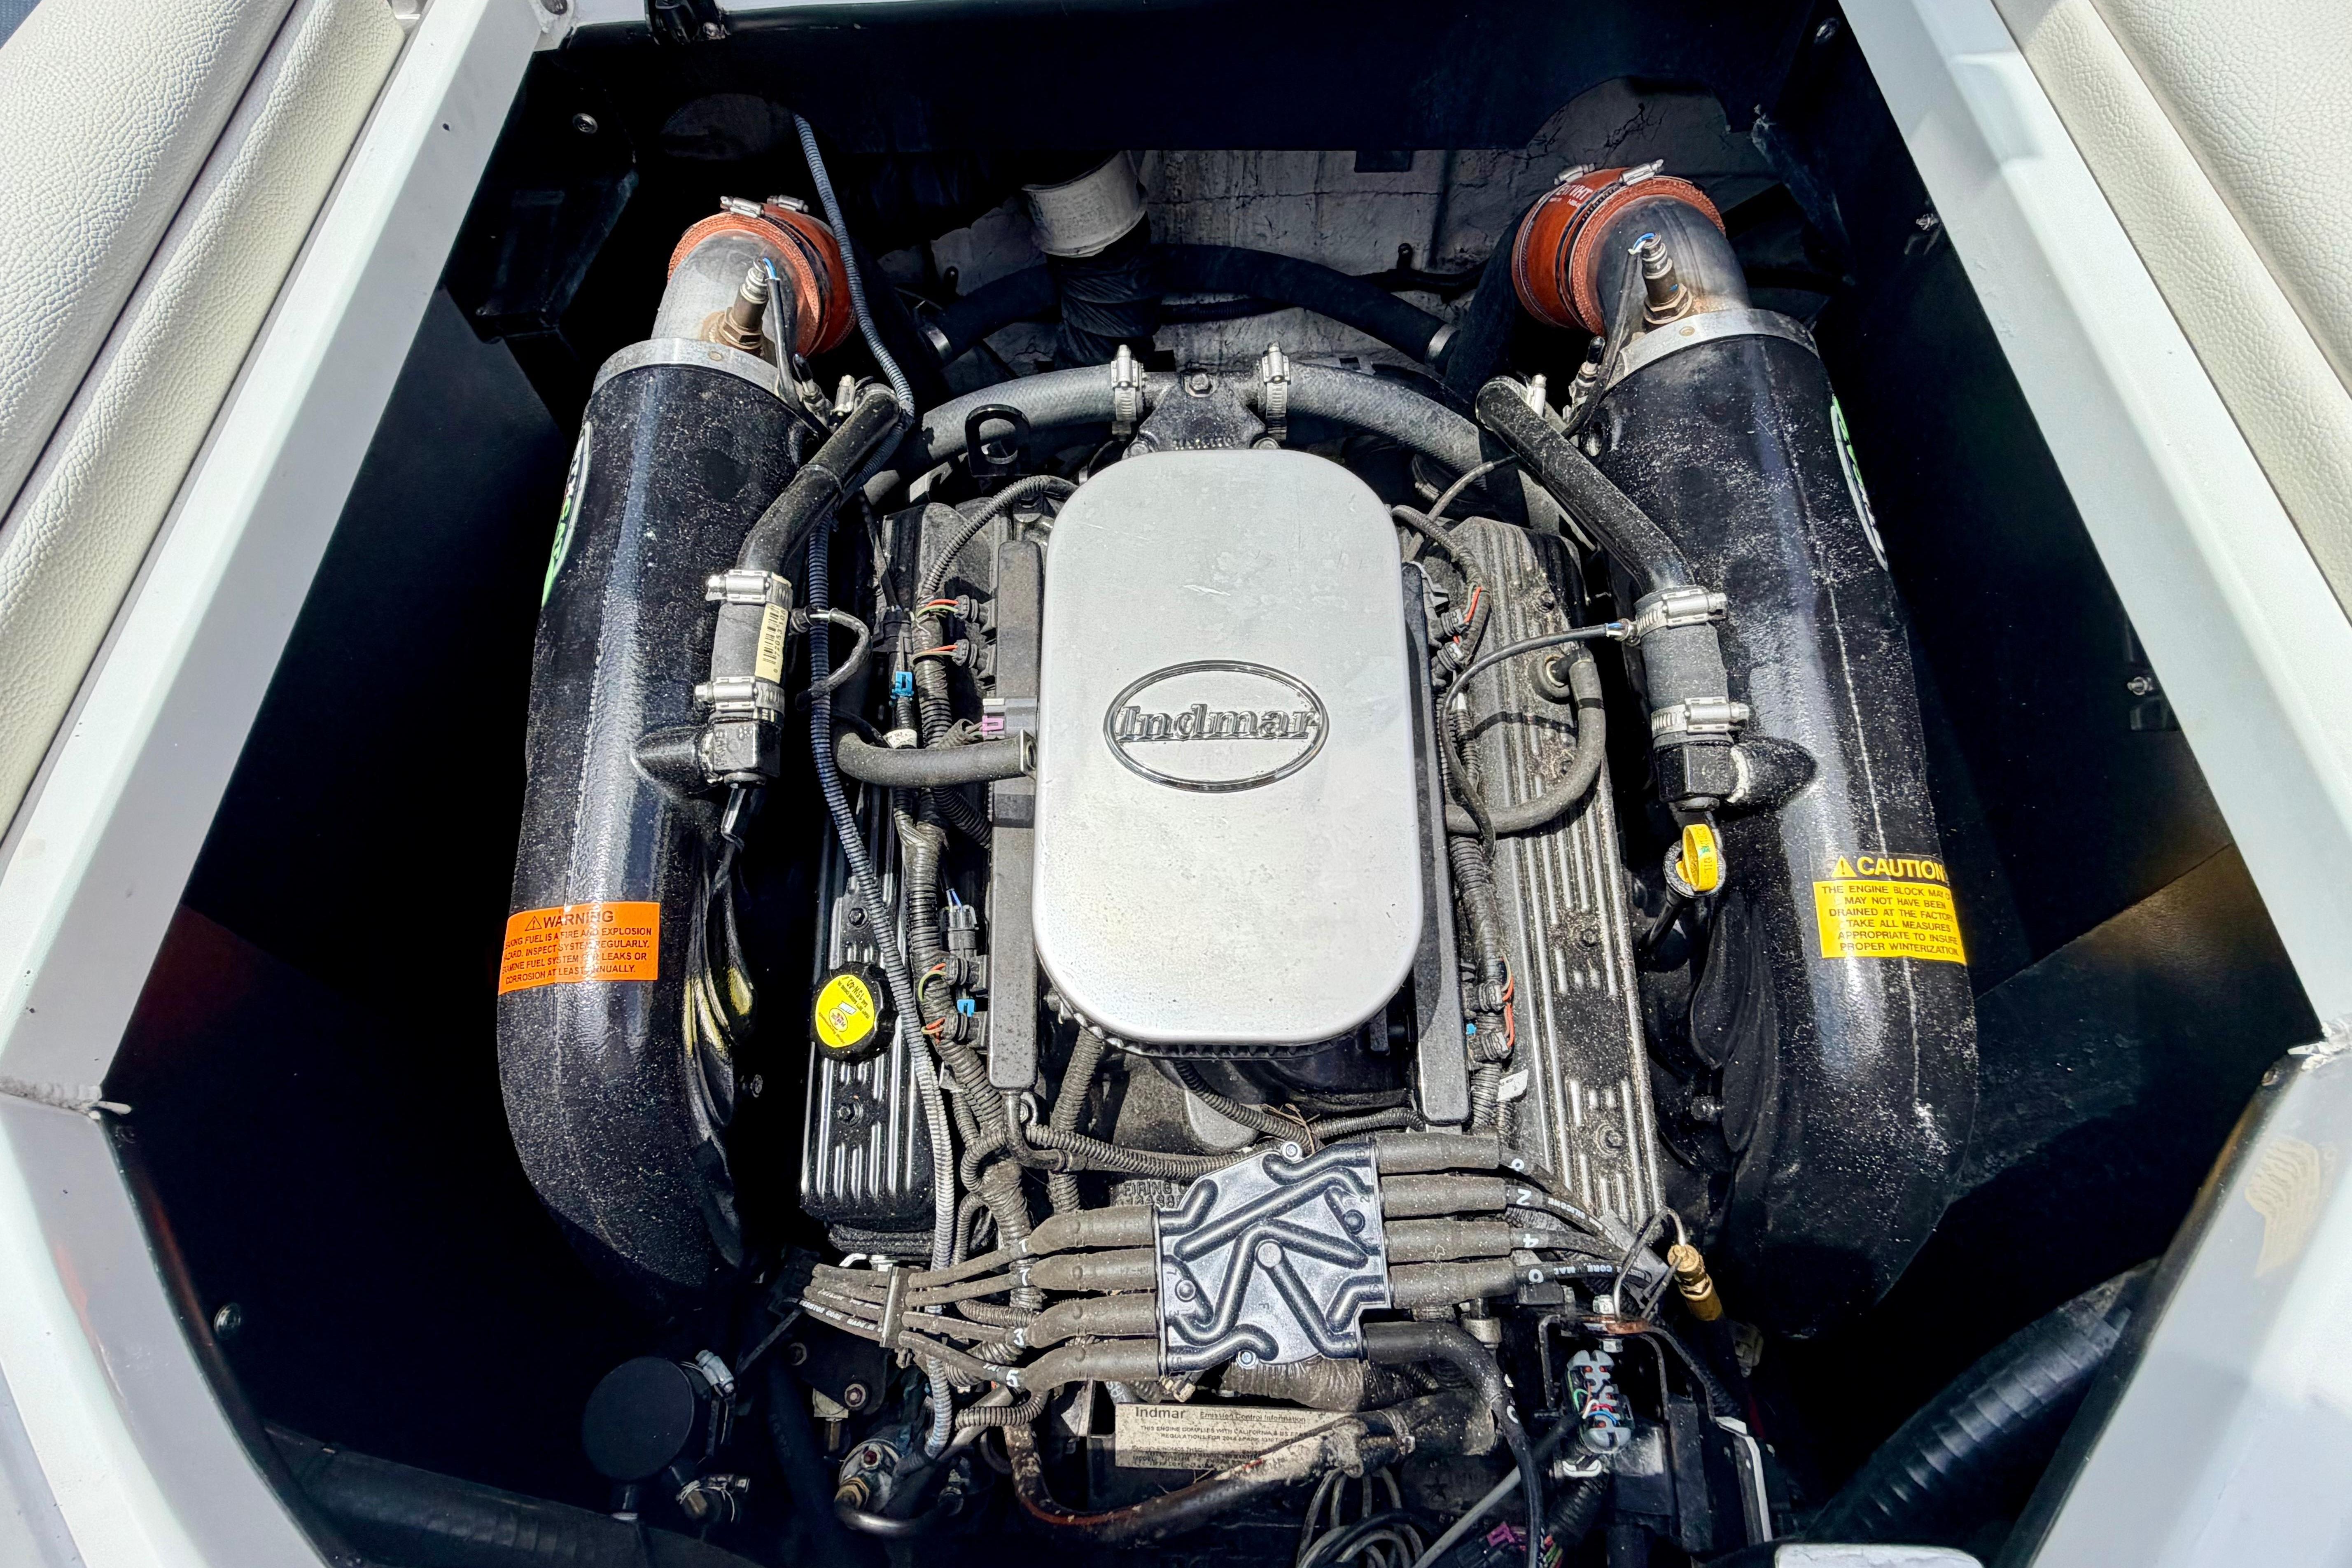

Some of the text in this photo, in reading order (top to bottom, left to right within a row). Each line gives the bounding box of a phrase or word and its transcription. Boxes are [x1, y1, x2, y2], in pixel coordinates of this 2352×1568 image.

[1115, 703, 1318, 741] Indmar
[1857, 856, 1946, 882] CAUTION
[1822, 886, 1843, 894] THE
[1894, 887, 1925, 896] BLOCK
[1845, 896, 1946, 909] MAY NOT HAVE BEEN
[544, 910, 614, 929] WARNING
[1829, 908, 1878, 917] DRAINED
[1898, 909, 1917, 918] THE
[1846, 919, 1875, 927] TAKE
[1902, 920, 1951, 932] MEASURES
[525, 934, 544, 944] FUEL
[545, 933, 552, 941] IS
[553, 932, 559, 940] A
[560, 930, 579, 939] FIRE
[602, 927, 651, 936] EXPLOSION
[1838, 931, 1958, 945] APPROPRIATE TO INSURE
[525, 944, 557, 956] INSPECT
[1840, 943, 1885, 951] PROPER
[526, 958, 545, 968] FUEL
[547, 955, 579, 965] SYSTEM
[602, 952, 632, 960] LEAKS
[635, 952, 647, 961] OR
[506, 971, 545, 985] CORROSION
[547, 968, 557, 978] AT
[558, 966, 586, 976] LEAST
[1516, 1188, 1586, 1220] 2 SILICONE
[1522, 1233, 1540, 1248] 4
[1013, 1328, 1024, 1346] 3
[1006, 1369, 1019, 1387] 5
[1136, 1407, 1186, 1419] Indmar
[1200, 1412, 1234, 1420] Emission
[1264, 1414, 1306, 1423] Information
